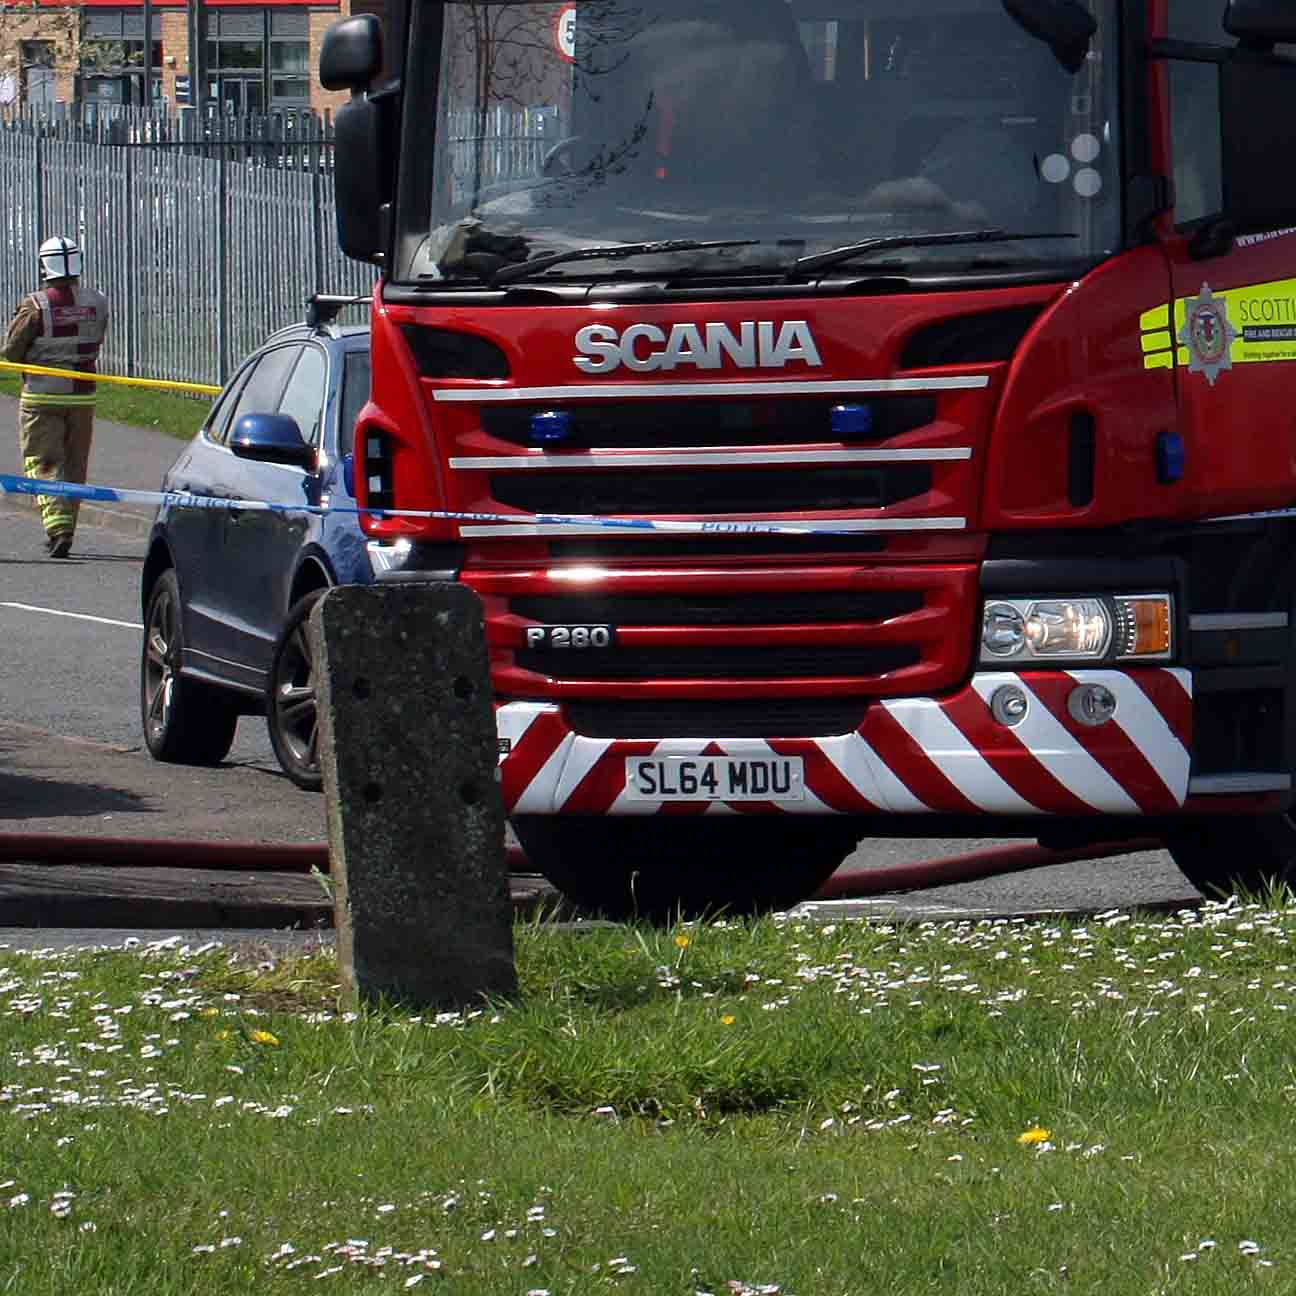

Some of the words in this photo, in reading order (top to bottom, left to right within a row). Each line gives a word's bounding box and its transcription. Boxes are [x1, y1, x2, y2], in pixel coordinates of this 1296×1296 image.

[573, 320, 823, 374] SCANIA
[527, 628, 545, 648] P
[551, 626, 610, 648] 280
[637, 761, 718, 795] SL64
[727, 761, 791, 795] MDU
